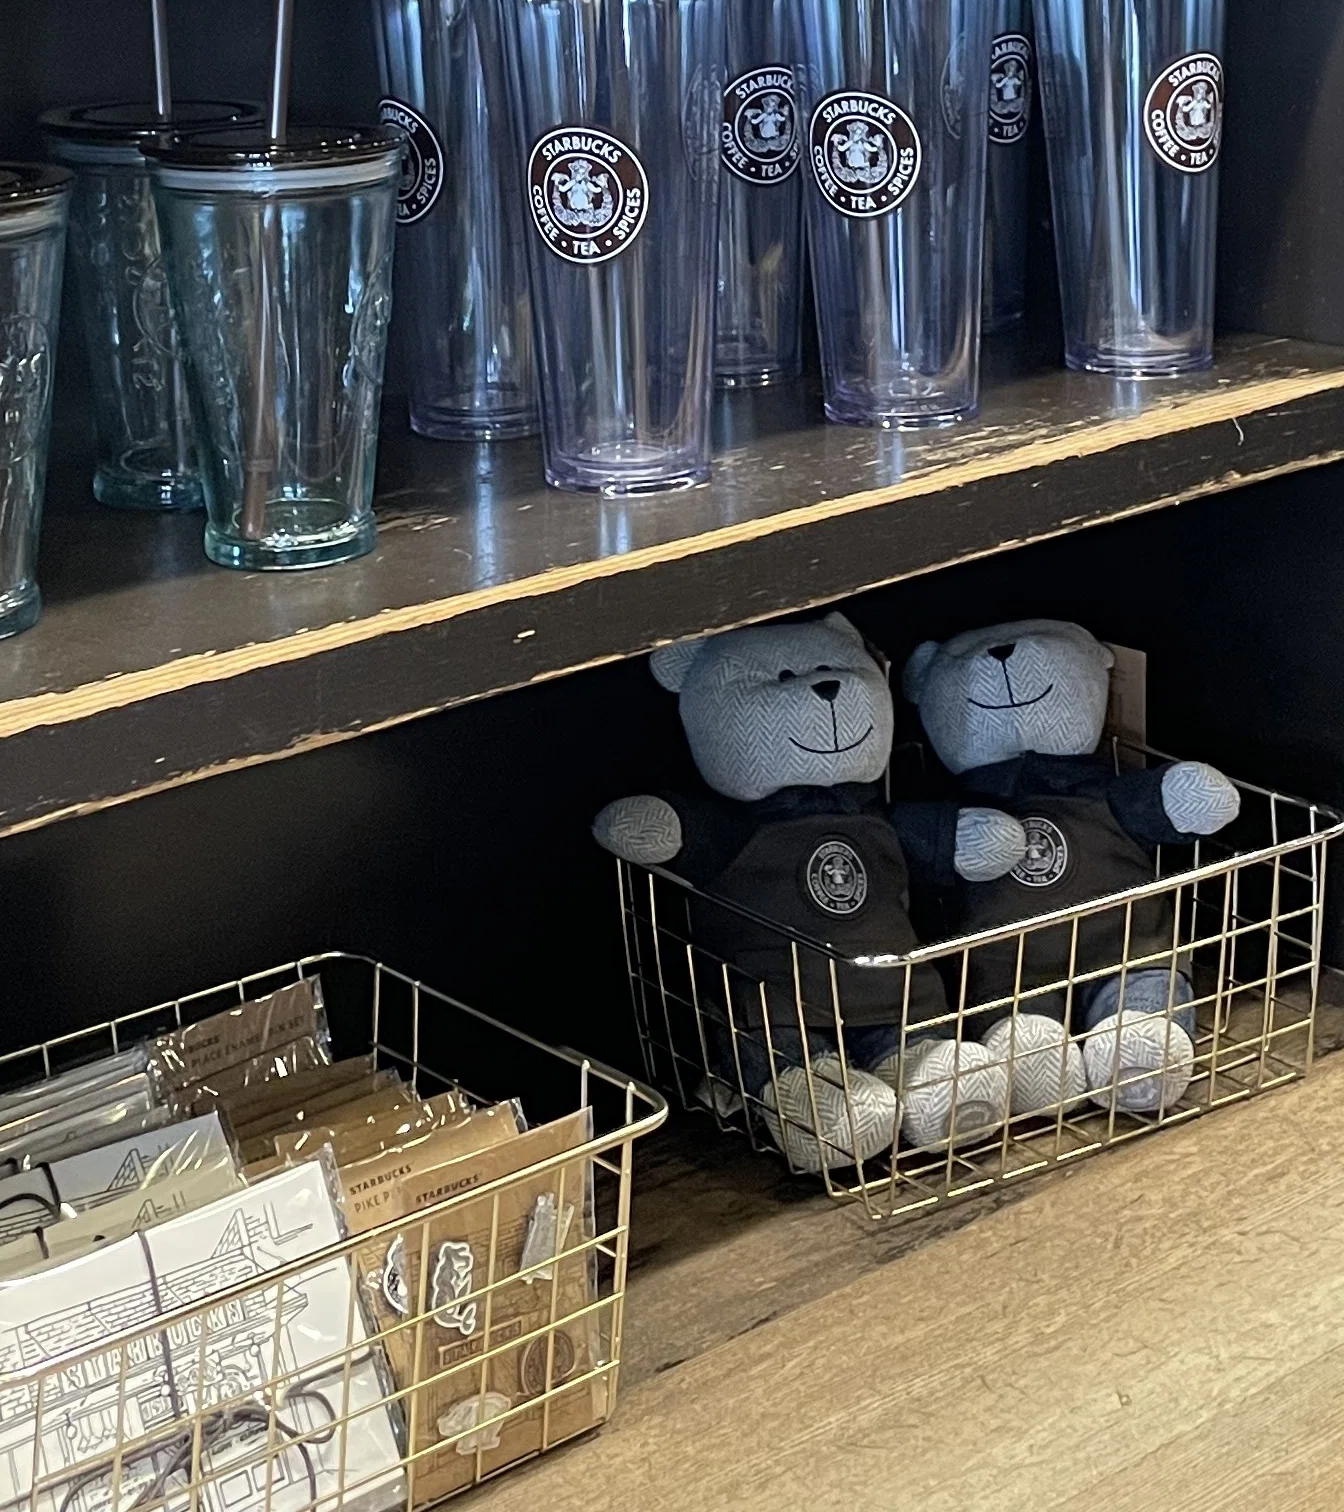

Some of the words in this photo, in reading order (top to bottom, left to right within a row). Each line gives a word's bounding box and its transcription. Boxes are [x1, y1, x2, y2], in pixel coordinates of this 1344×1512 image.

[735, 74, 795, 99] STARBUCK
[822, 99, 897, 125] STARBUCKS
[542, 135, 622, 164] STARBUCKS
[722, 122, 749, 169] COFFEE
[761, 163, 783, 178] TEA
[1151, 109, 1180, 158] COFFEE
[1190, 151, 1208, 166] TEA
[416, 157, 436, 205] SPICES
[813, 145, 839, 198] COFFEE
[850, 195, 877, 210] TEA
[887, 147, 914, 196] SPICES
[532, 184, 561, 242] COFFEE
[572, 240, 602, 256] TEA
[612, 187, 641, 241] SPICES
[349, 1164, 413, 1196] STARBUCKS
[415, 1172, 481, 1205] STARBUCKS
[354, 1192, 382, 1214] PIKE
